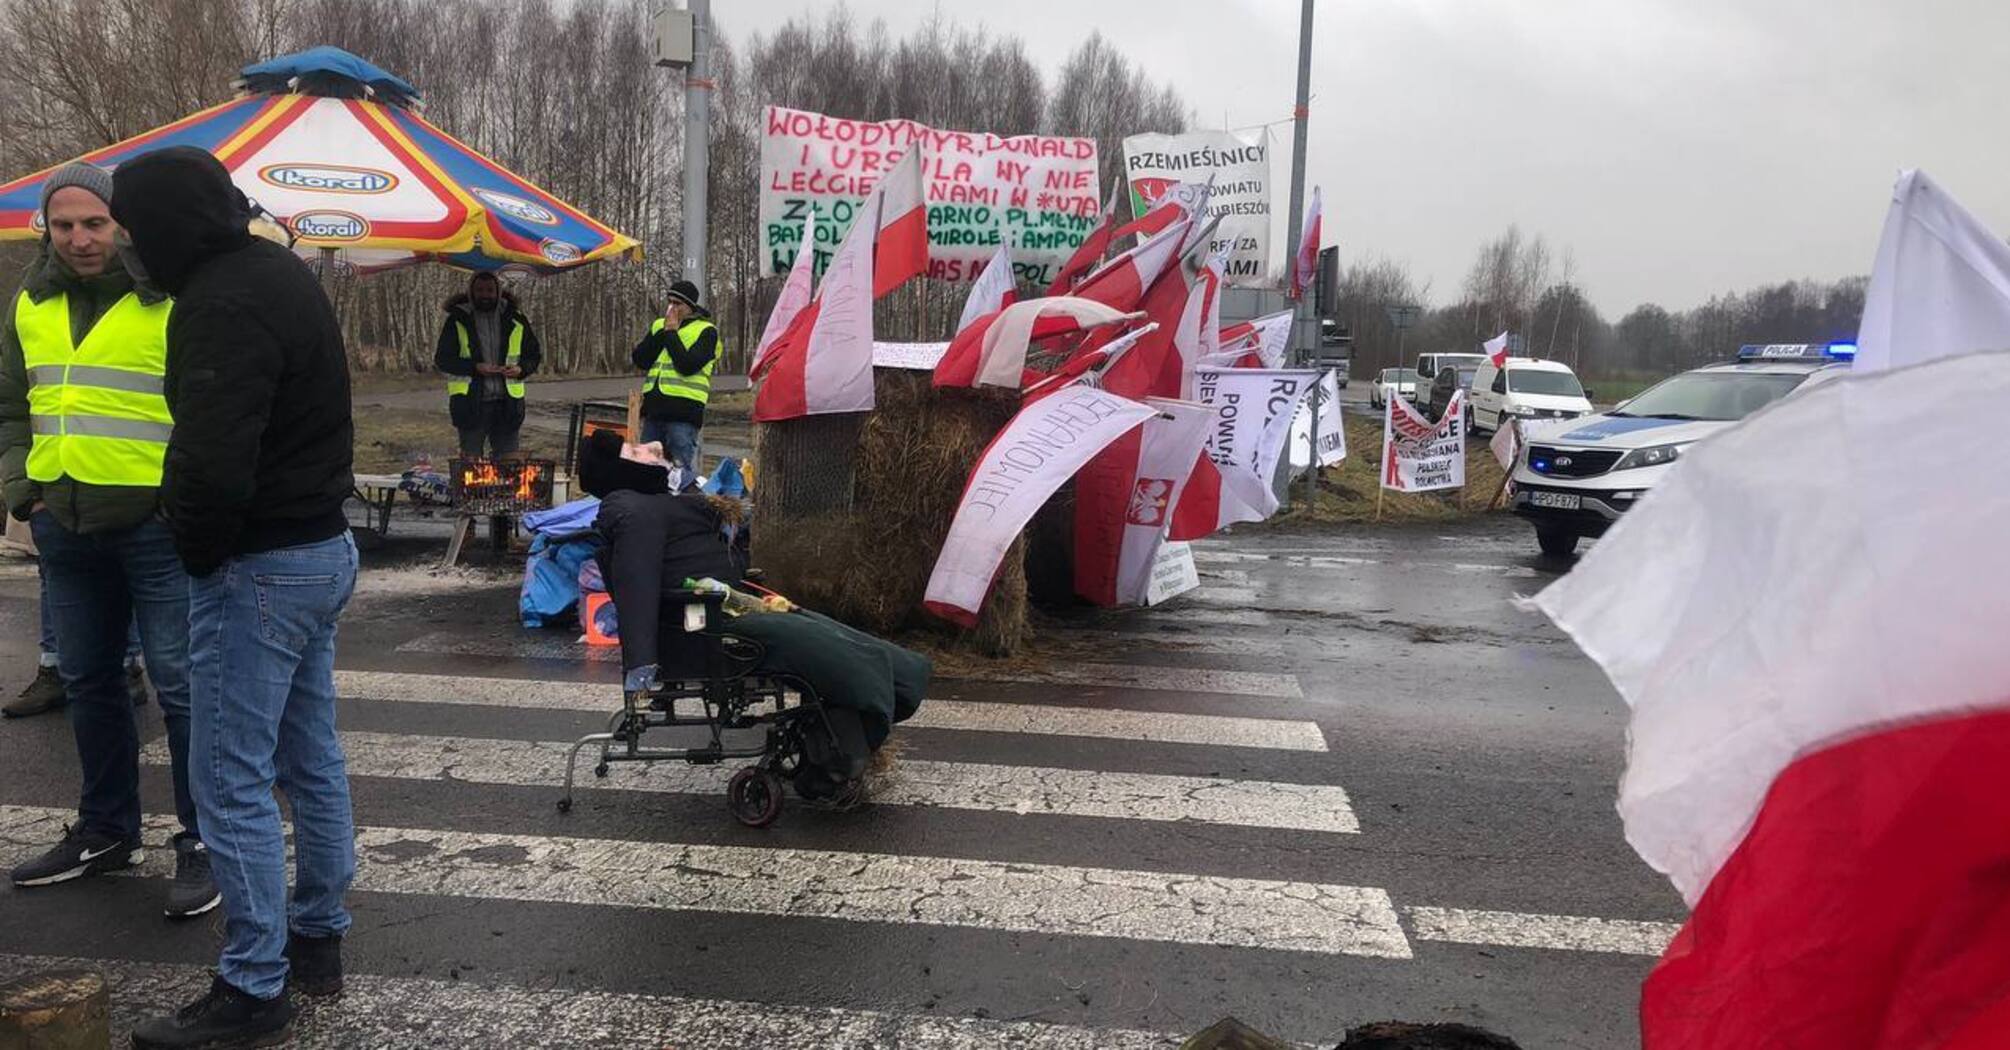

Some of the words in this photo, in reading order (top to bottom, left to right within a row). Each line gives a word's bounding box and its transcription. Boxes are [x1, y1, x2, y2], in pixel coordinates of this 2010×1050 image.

[801, 144, 810, 166] I
[1044, 170, 1094, 190] NIE
[1129, 145, 1266, 171] RZEMIEŚLNICY
[281, 170, 377, 190] koral
[771, 168, 879, 197] LEĆCIE
[929, 182, 998, 206] NAMI
[1010, 187, 1028, 208] W
[1206, 180, 1262, 199] OWIATU
[304, 217, 359, 236] koral
[1241, 238, 1258, 250] ZA
[1224, 259, 1258, 275] AMI
